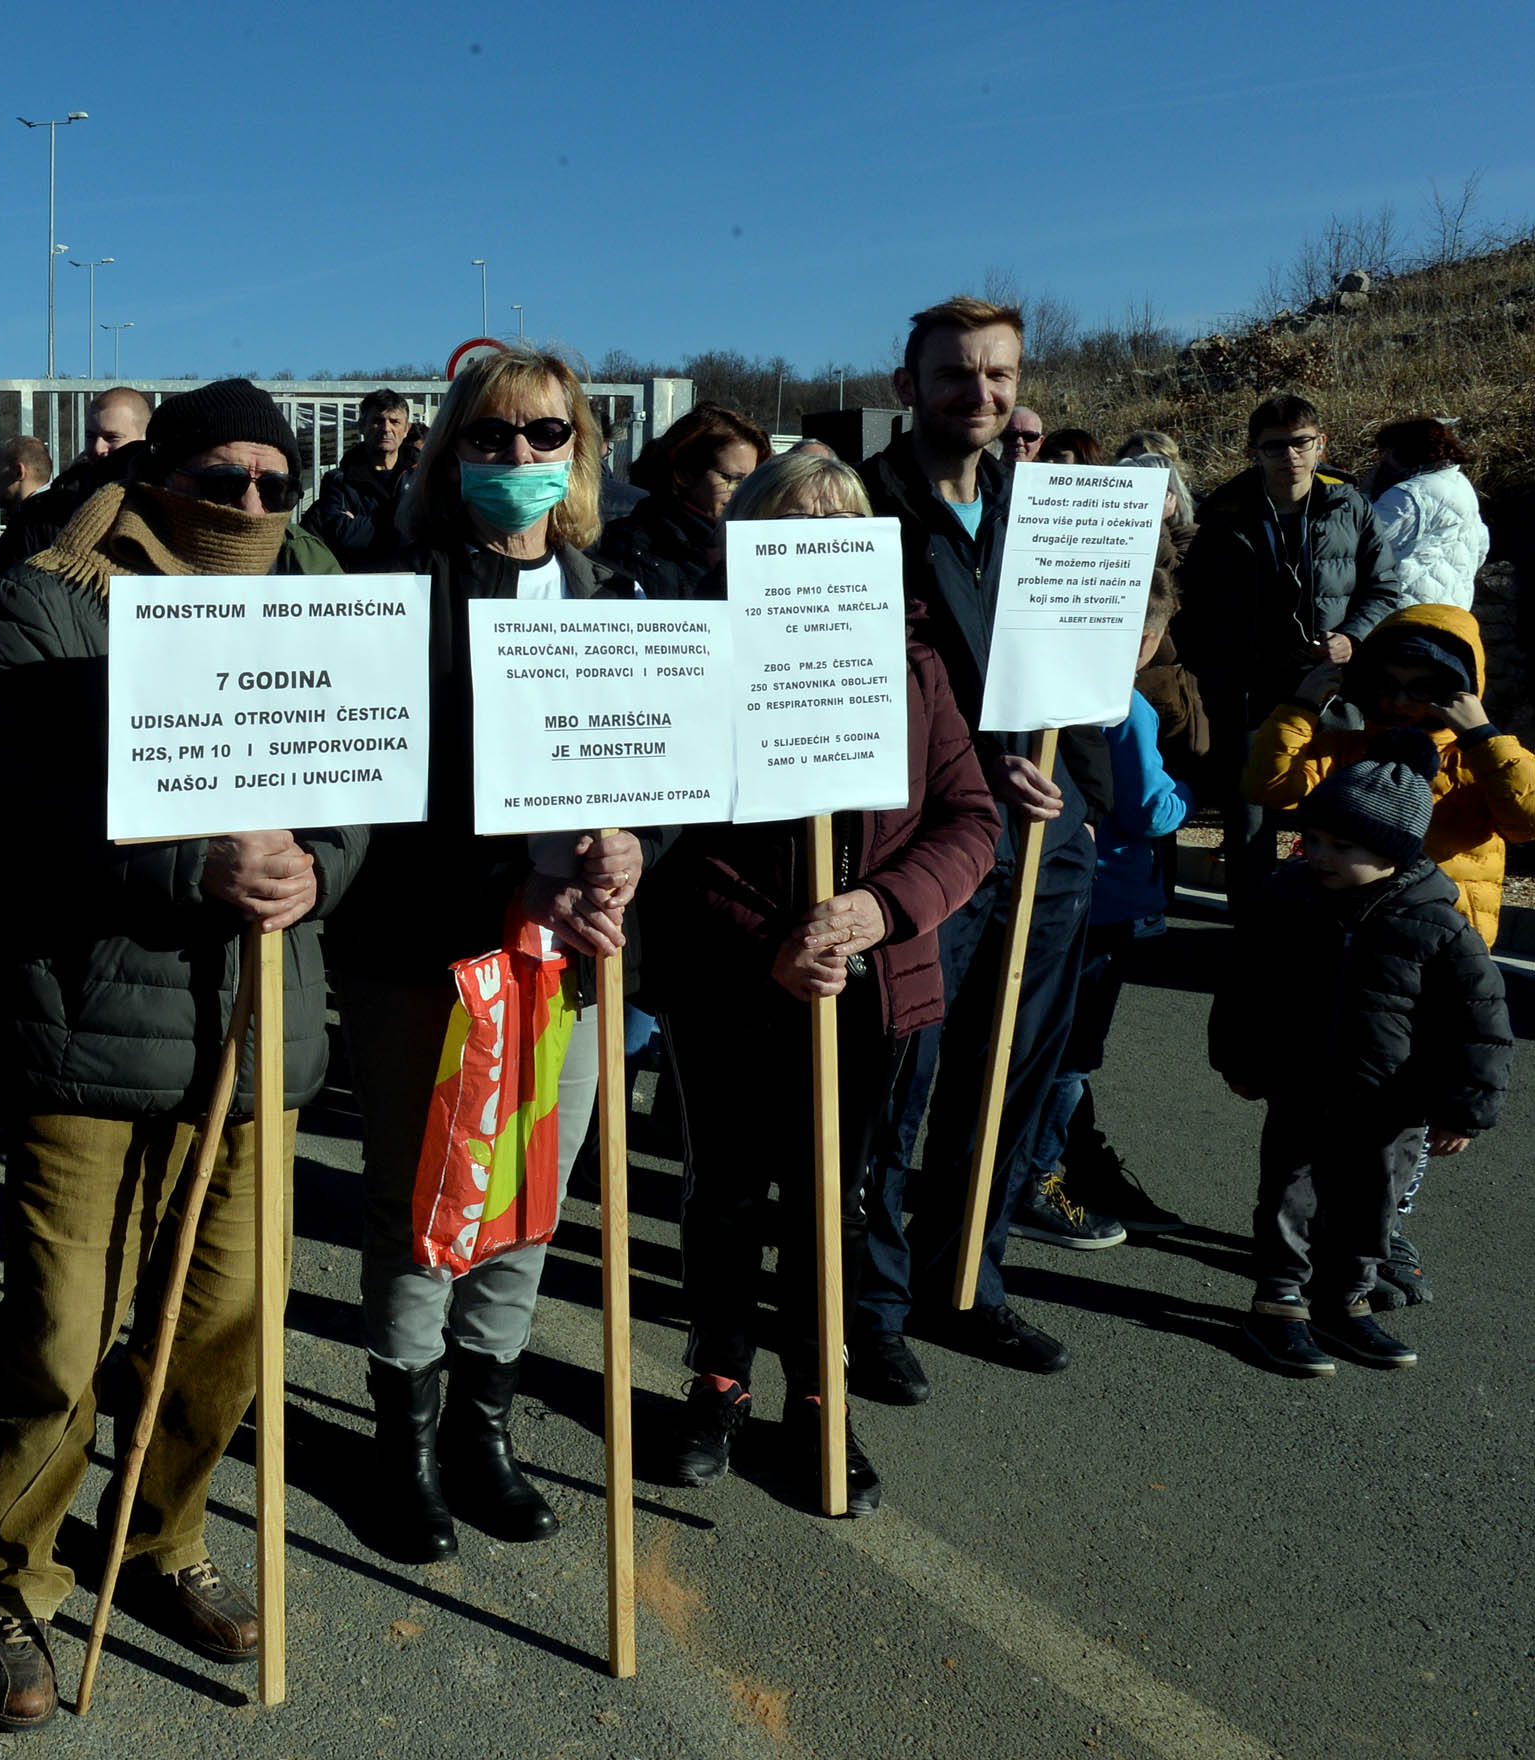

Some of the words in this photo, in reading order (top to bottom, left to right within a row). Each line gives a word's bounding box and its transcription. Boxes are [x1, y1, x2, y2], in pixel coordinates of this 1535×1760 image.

[1048, 476, 1073, 486] MBO
[1075, 477, 1134, 488] MARIŠĆINA
[1027, 497, 1070, 506] "Ludost:
[1071, 499, 1099, 507] raditi
[1101, 499, 1121, 508] istu
[1122, 501, 1149, 509] stvar
[1017, 515, 1050, 524] iznova
[1052, 516, 1074, 525] više
[1074, 518, 1099, 527] puta
[1100, 518, 1105, 526] i
[755, 543, 788, 557] MBO
[795, 538, 875, 556] MARIŠĆINA
[1034, 558, 1053, 566] "Ne
[1098, 559, 1131, 570] riješiti
[1016, 576, 1064, 586] probleme
[1080, 577, 1098, 585] isti
[764, 587, 792, 597] ZBOG
[796, 585, 822, 596] PM10
[826, 583, 868, 594] ČESTICA
[1029, 594, 1048, 605] koji
[1071, 595, 1082, 603] ih
[135, 603, 246, 620] MONSTRUM
[262, 603, 303, 618] MBO
[308, 599, 407, 618] MARIŠĆINA
[744, 607, 762, 617] 120
[767, 604, 830, 616] STANOVNIKA
[493, 622, 557, 635] ISTRIJANI,
[560, 622, 634, 635] DALMATINCI,
[636, 620, 711, 634] DUBROVČANI,
[803, 622, 853, 633] UMRIJETI,
[497, 643, 578, 657] KARLOVČANI,
[583, 644, 639, 657] ZAGORCI,
[644, 644, 711, 657] MEĐIMURCI,
[506, 668, 569, 680] SLAVONCI,
[575, 667, 634, 679] PODRAVCI
[643, 667, 647, 677] I
[656, 666, 705, 677] POSAVCI
[763, 662, 791, 673] ZBOG
[799, 660, 828, 671] PM.25
[832, 658, 874, 669] ČESTICA
[216, 672, 230, 691] 7
[237, 669, 333, 691] GODINA
[750, 683, 768, 693] 250
[772, 679, 836, 691] STANOVNIKA
[840, 675, 888, 687] OBOLJETI
[746, 702, 761, 712] OD
[766, 696, 844, 710] RESPIRATORNIH
[848, 694, 892, 705] BOLESTI,
[130, 712, 224, 730] UDISANJA
[234, 708, 326, 726] OTROVNIH
[336, 705, 410, 722] ČESTICA
[544, 714, 579, 729] MBO
[588, 710, 672, 728] MARIŠĆINA
[761, 739, 769, 749] U
[835, 734, 841, 743] 5
[843, 731, 881, 743] GODINA
[131, 746, 173, 764] H2S,
[178, 744, 205, 760] PM
[210, 743, 231, 759] 10
[247, 743, 253, 757] I
[268, 736, 409, 756] SUMPORVODIKA
[551, 744, 571, 758] JE
[579, 741, 666, 758] MONSTRUM
[767, 756, 796, 767] SAMO
[800, 755, 808, 765] U
[157, 774, 218, 793] NAŠOJ
[234, 772, 286, 789] DJECI
[291, 772, 297, 786] I
[302, 768, 384, 786] UNUCIMA
[504, 797, 521, 808] NE
[523, 794, 583, 808] MODERNO
[585, 791, 664, 805] ZBRIJAVANJE
[666, 788, 711, 801] OTPADA
